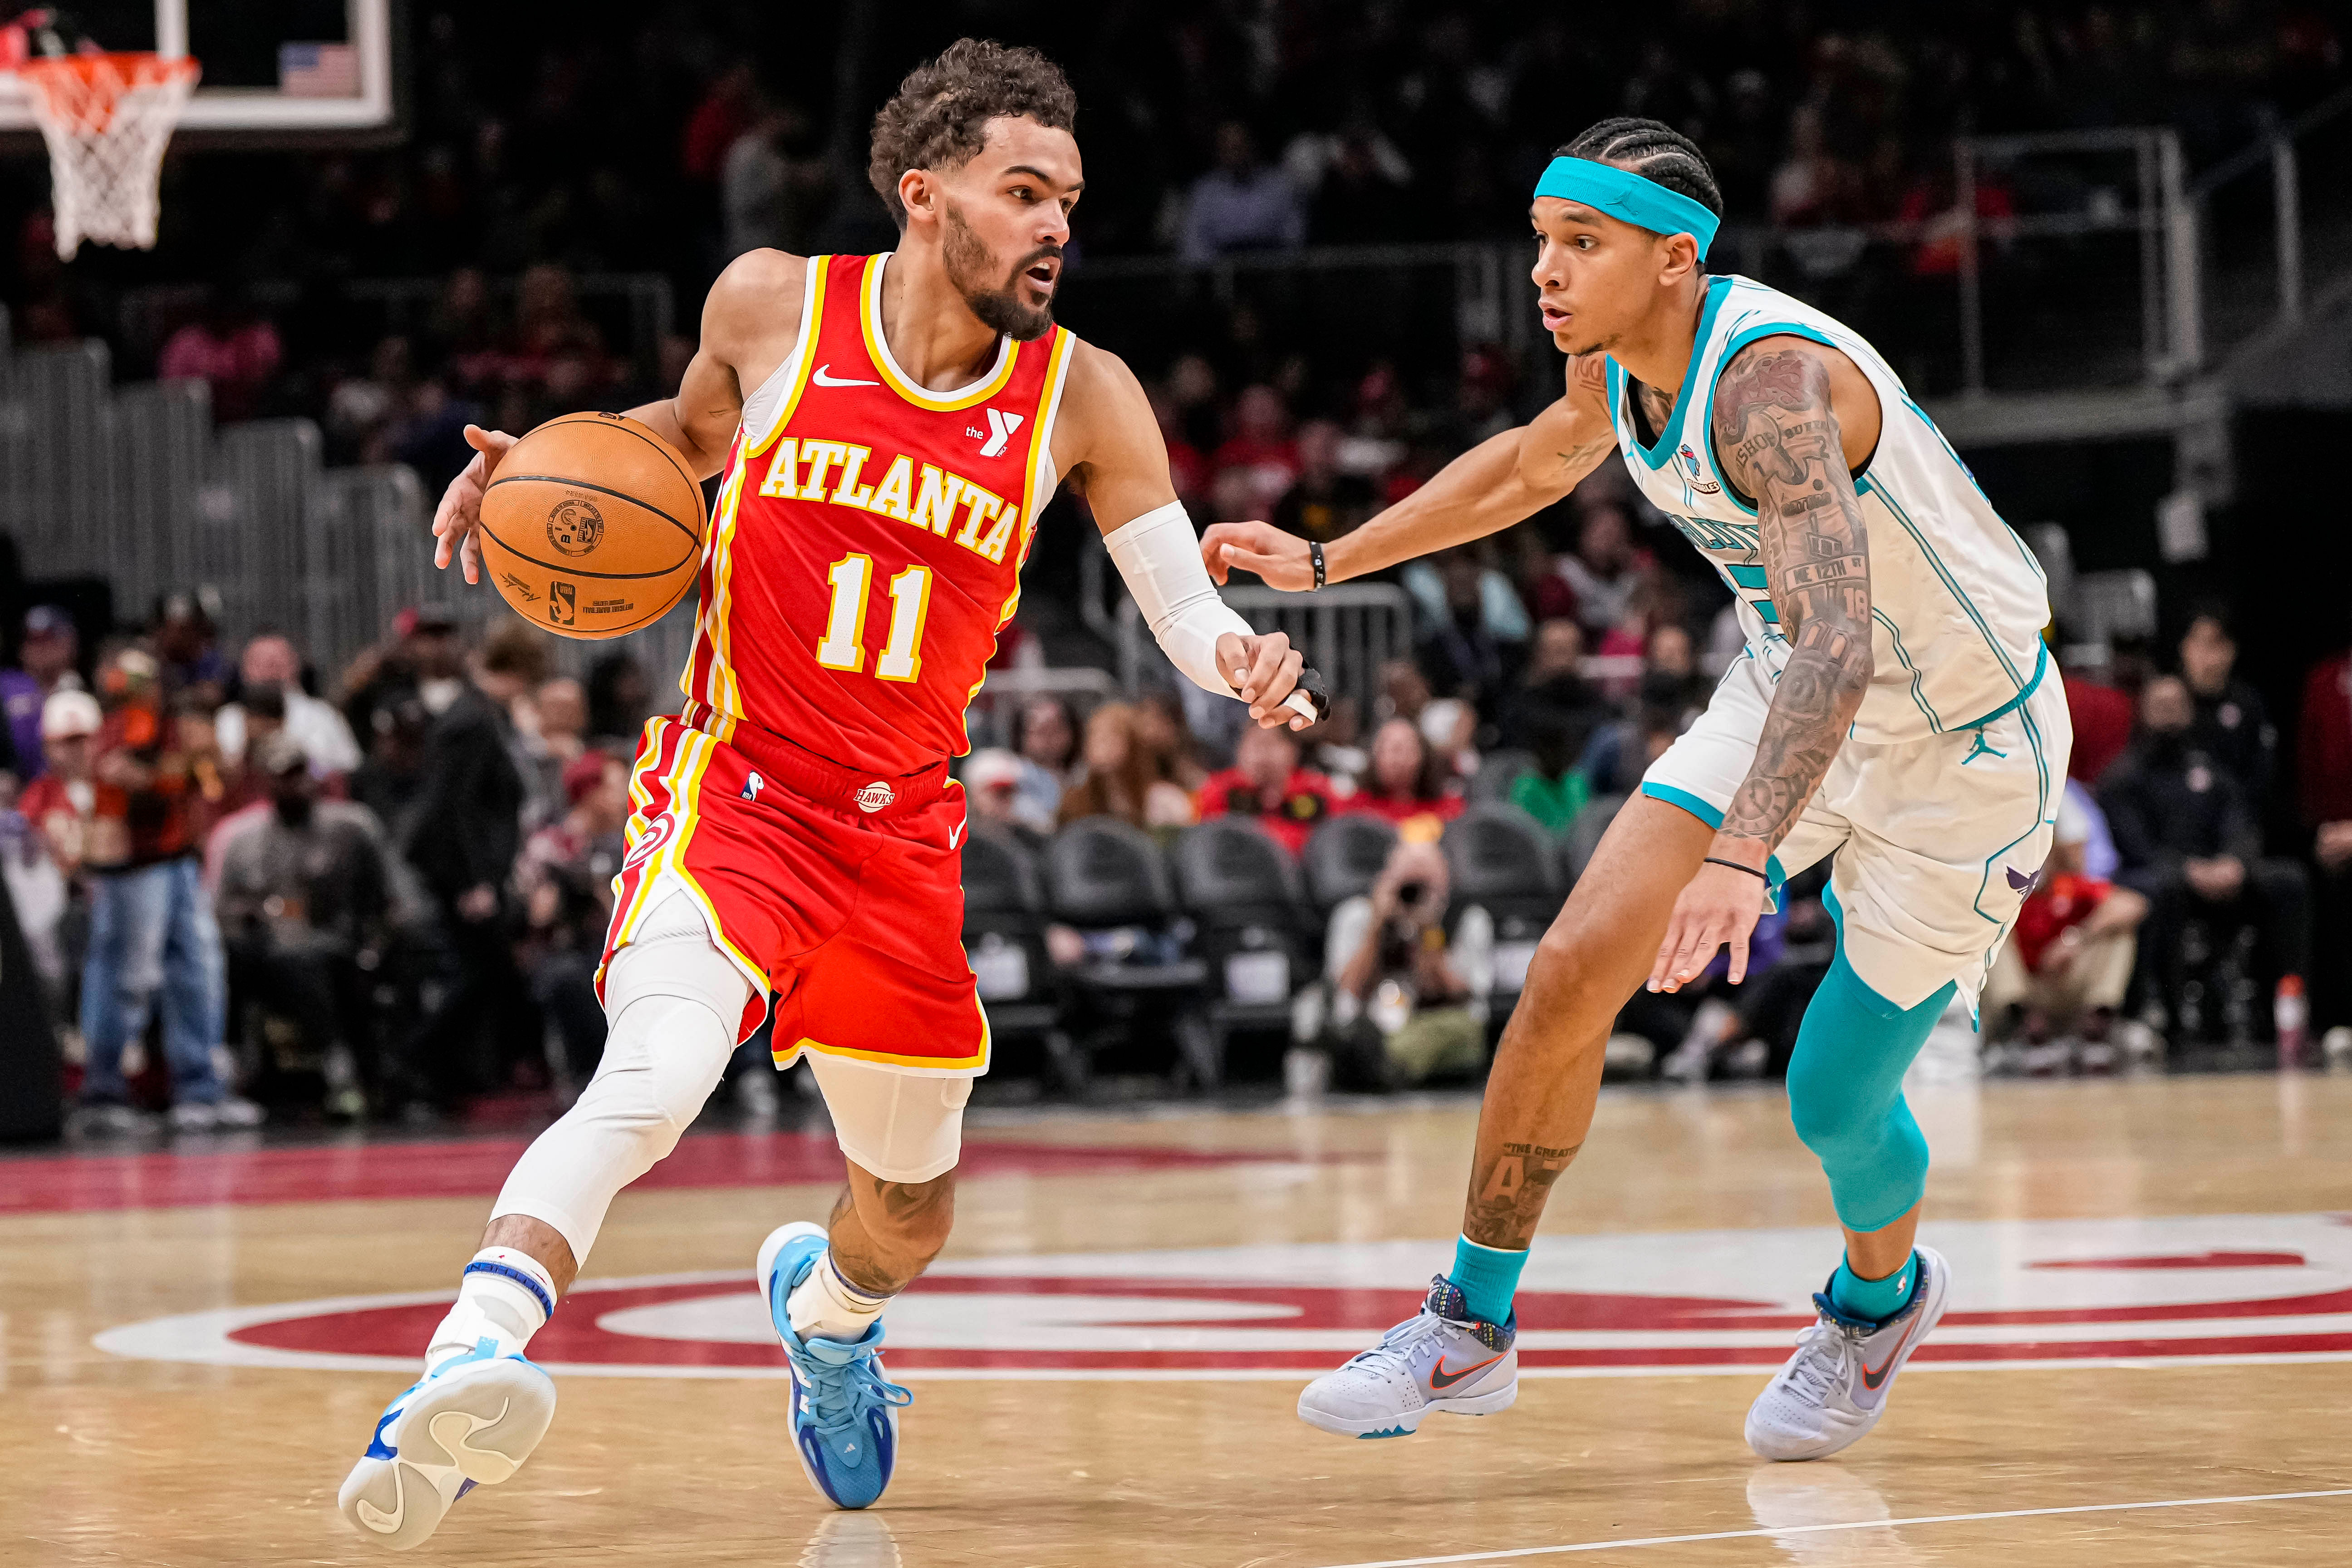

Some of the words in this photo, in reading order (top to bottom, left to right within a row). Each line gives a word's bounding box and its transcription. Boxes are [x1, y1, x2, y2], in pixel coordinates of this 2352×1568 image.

[966, 426, 984, 439] the
[759, 437, 1020, 565] ATLANTA
[816, 552, 933, 683] 11
[741, 791, 752, 801] NBA
[854, 789, 894, 805] HAWKS
